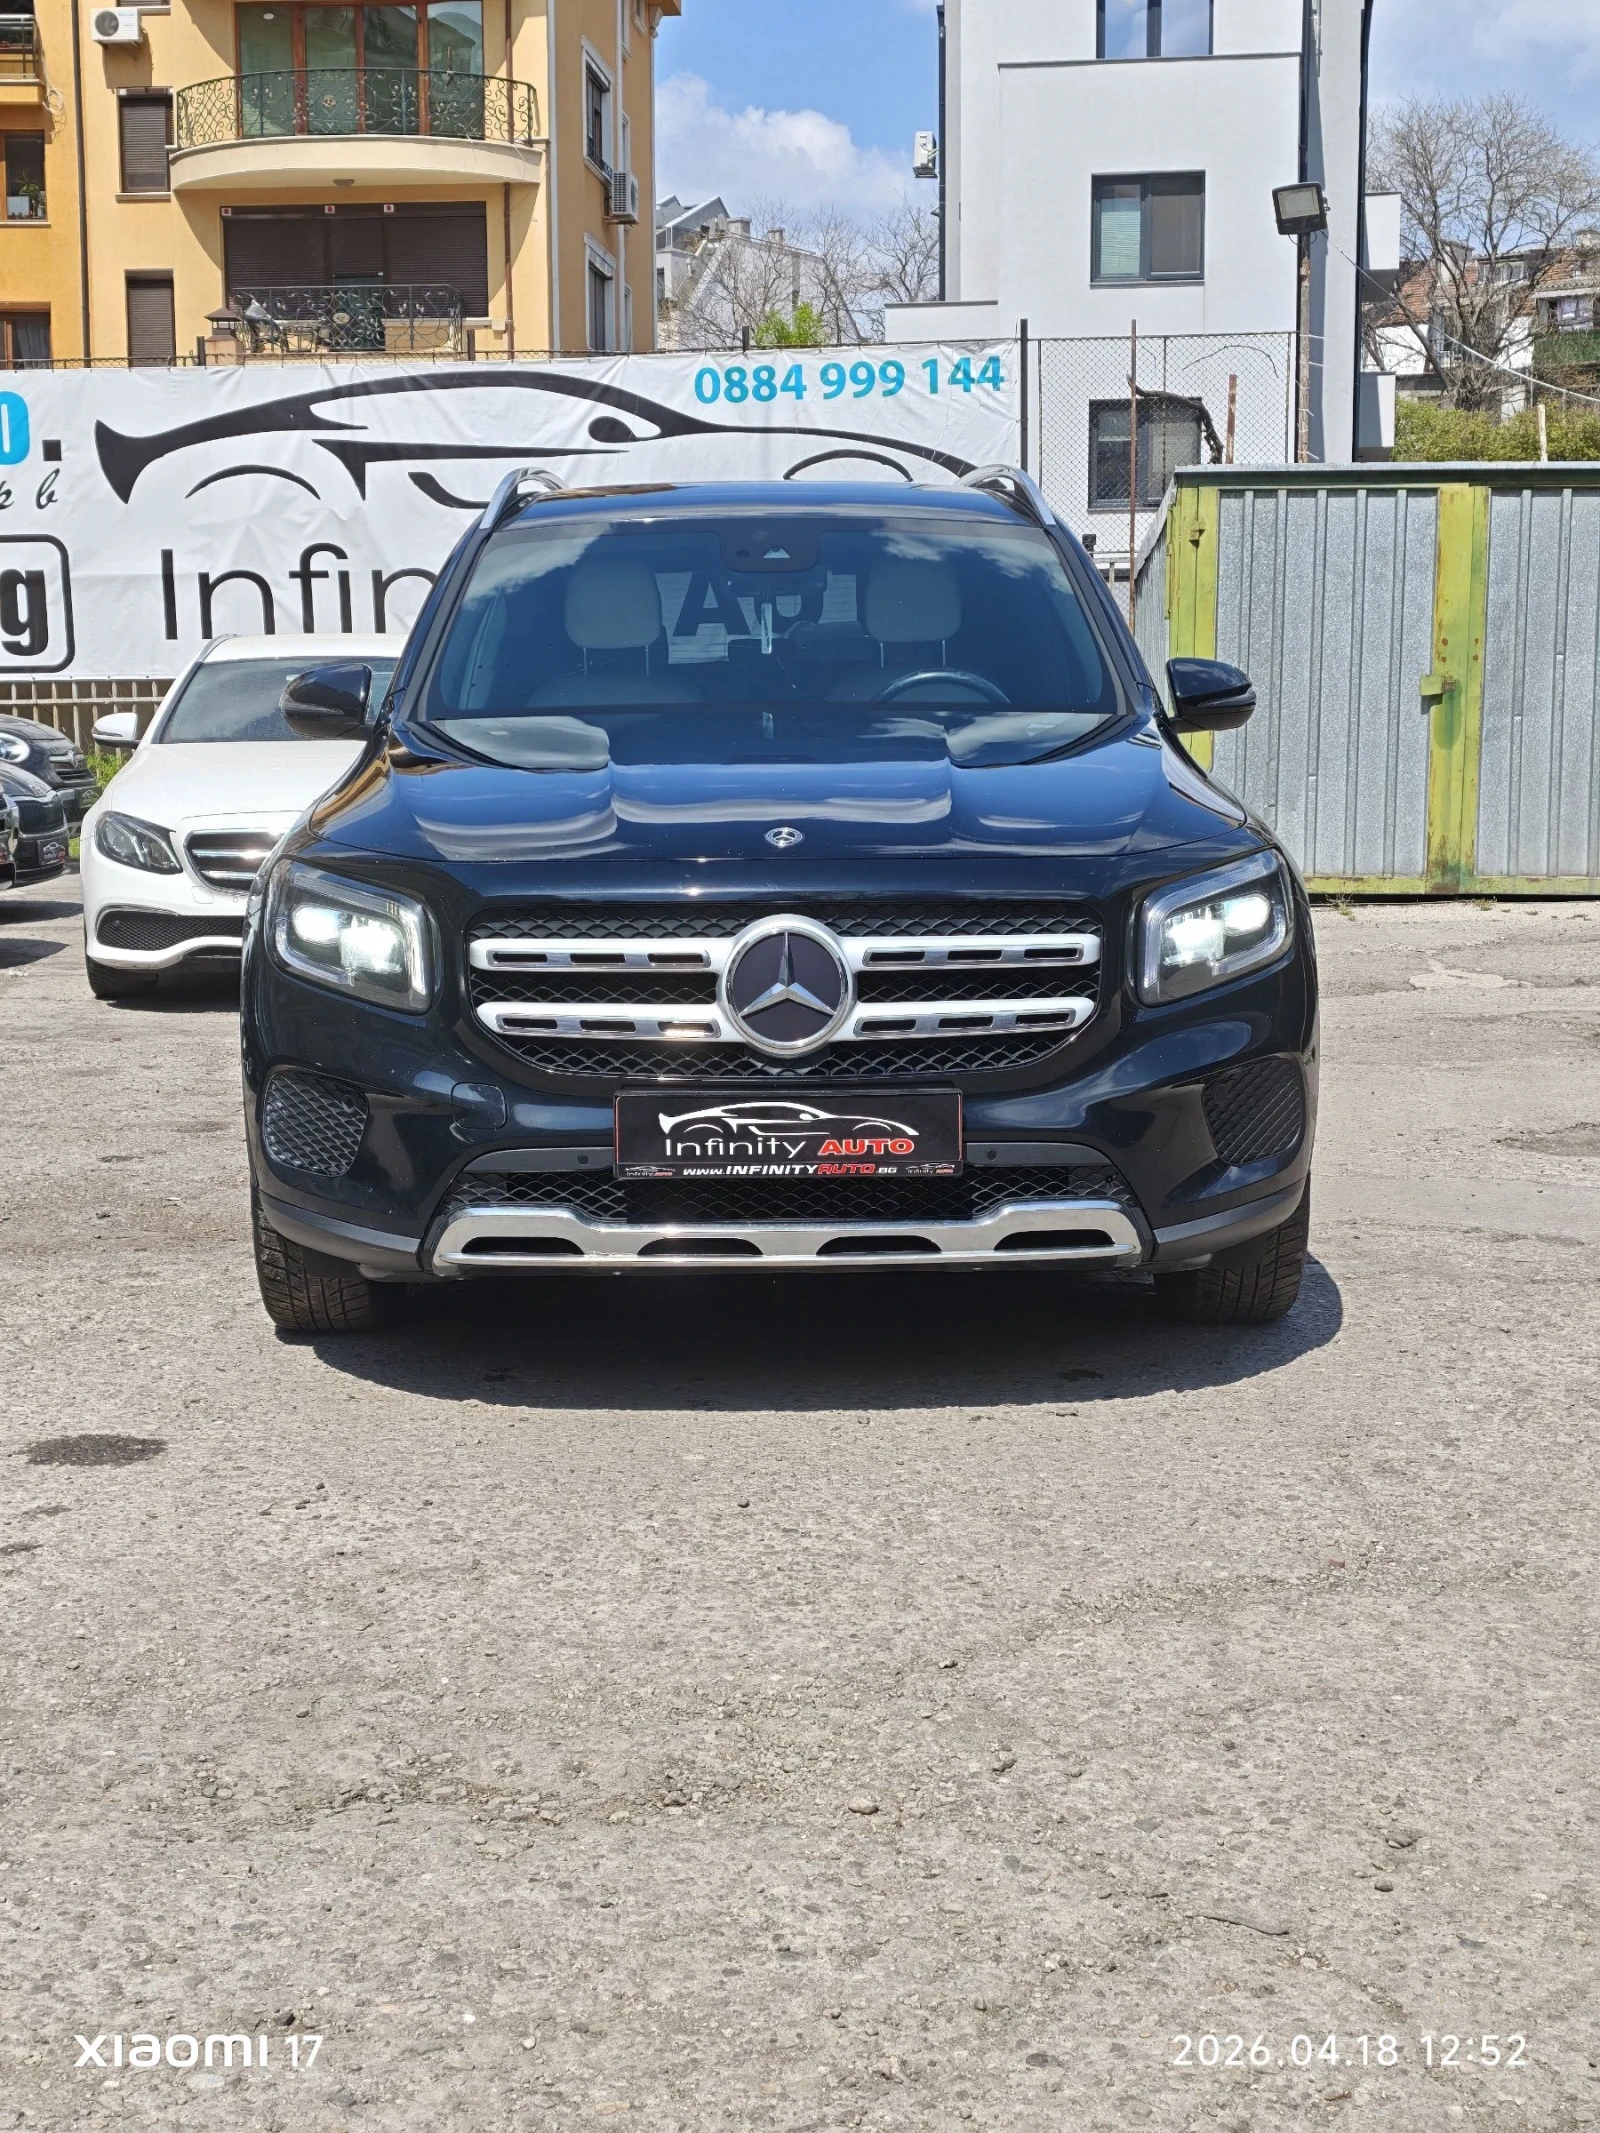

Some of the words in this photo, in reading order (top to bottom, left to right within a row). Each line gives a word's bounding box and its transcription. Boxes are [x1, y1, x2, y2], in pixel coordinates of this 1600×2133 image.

[694, 364, 807, 404] 0884
[819, 360, 906, 400] 999
[921, 355, 1005, 395] 144
[665, 1137, 807, 1159] Infinity
[818, 1138, 915, 1156] AUTO
